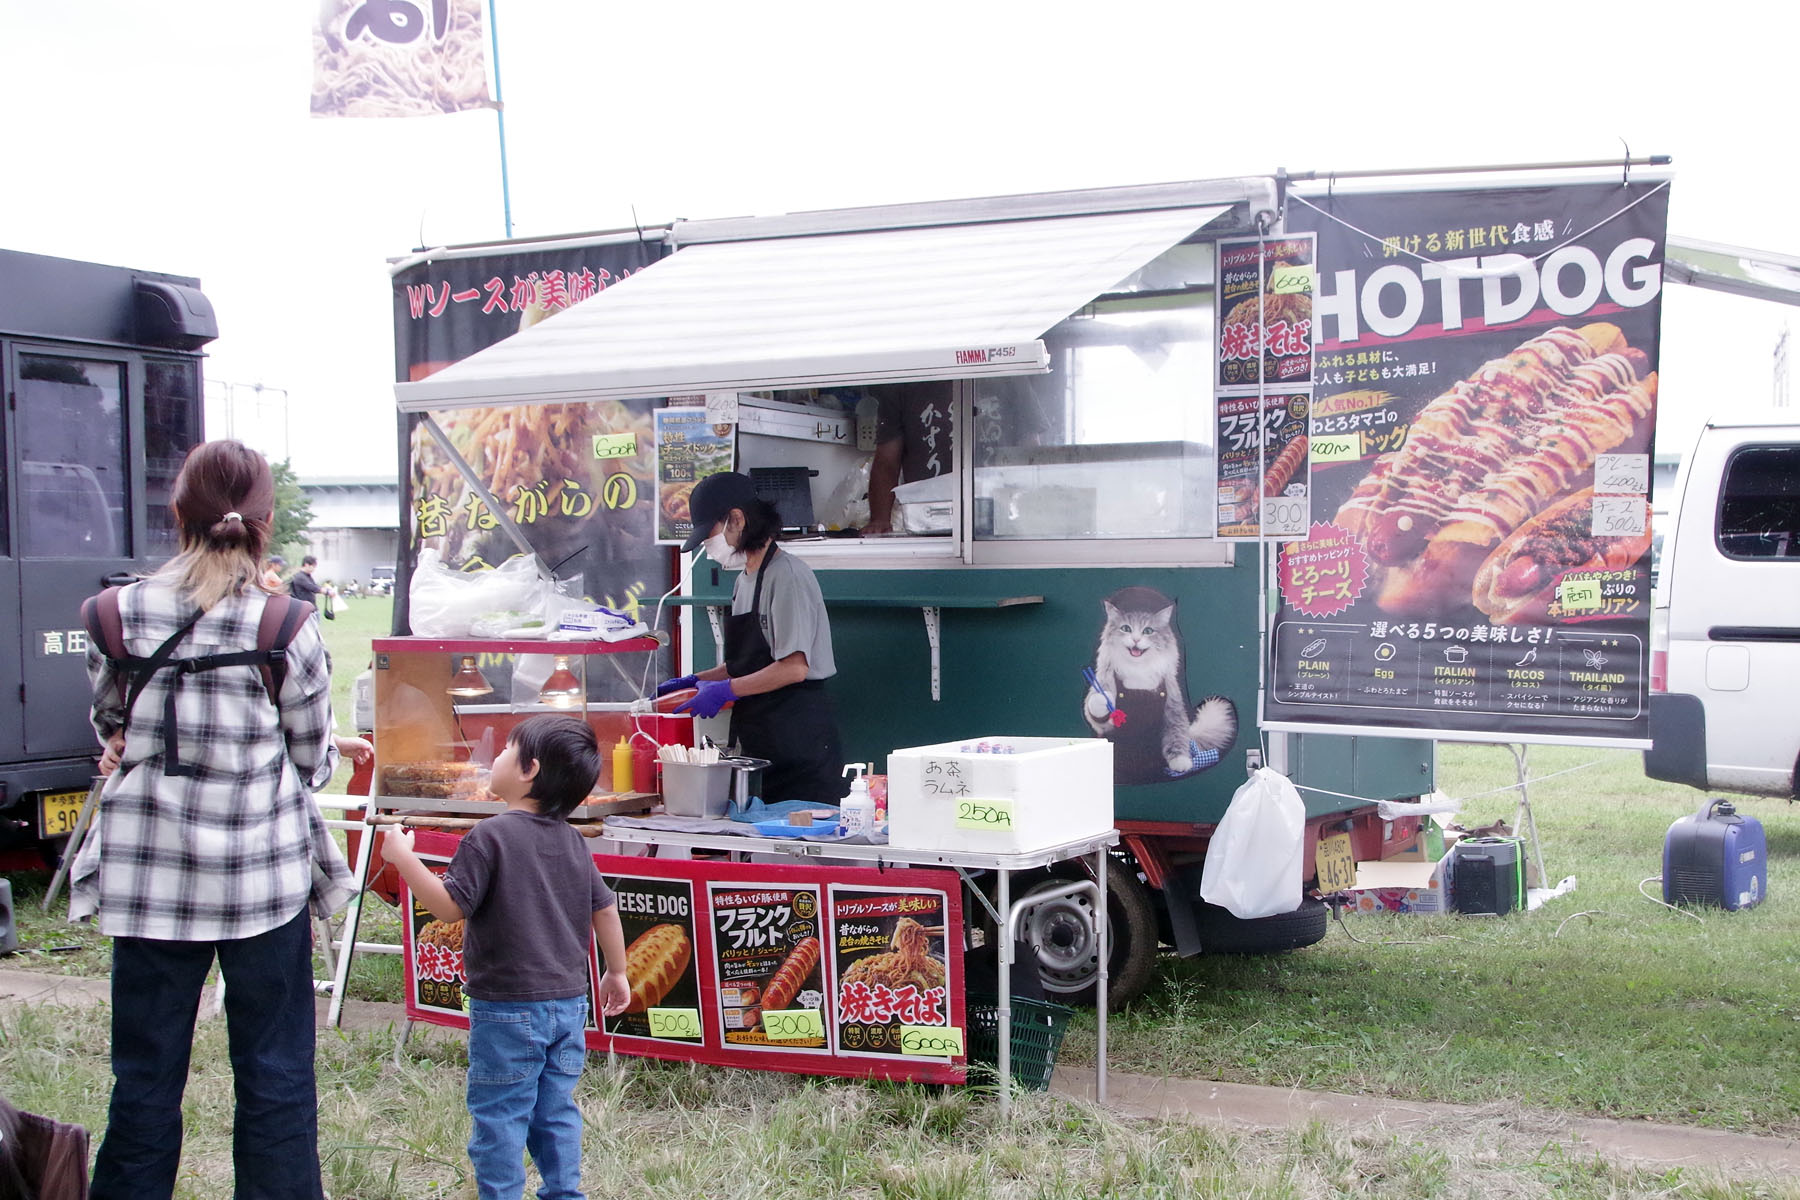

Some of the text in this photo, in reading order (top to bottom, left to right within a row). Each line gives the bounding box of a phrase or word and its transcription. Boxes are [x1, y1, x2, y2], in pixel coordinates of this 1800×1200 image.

[1382, 219, 1554, 258] 弾ける新世代食感
[1314, 237, 1662, 344] HOTDOG
[1220, 319, 1312, 362] 焼きそば
[955, 349, 987, 365] FIAMMA
[1314, 350, 1400, 368] ふれる具材に、
[1321, 394, 1382, 413] 人気No.1!
[1220, 408, 1287, 437] フランク
[1229, 427, 1278, 451] フルト
[417, 471, 638, 539] 昔ながらの
[1265, 502, 1302, 525] 300
[1301, 578, 1353, 606] チーズ
[1566, 587, 1593, 604] 売切
[1370, 620, 1553, 645] 選べる5つの美味しさ!
[1298, 660, 1330, 671] PLAIN
[1374, 668, 1395, 680] Egg
[1434, 666, 1476, 677] ITALIAN
[1506, 669, 1545, 680] TACOS
[1569, 671, 1625, 683] THAILAND
[923, 780, 971, 797] ラムネ
[656, 894, 689, 917] DOG
[716, 905, 791, 933] フランク
[839, 923, 879, 934] 昔ながらの
[727, 925, 784, 950] フルト
[839, 980, 946, 1026] 焼きそば
